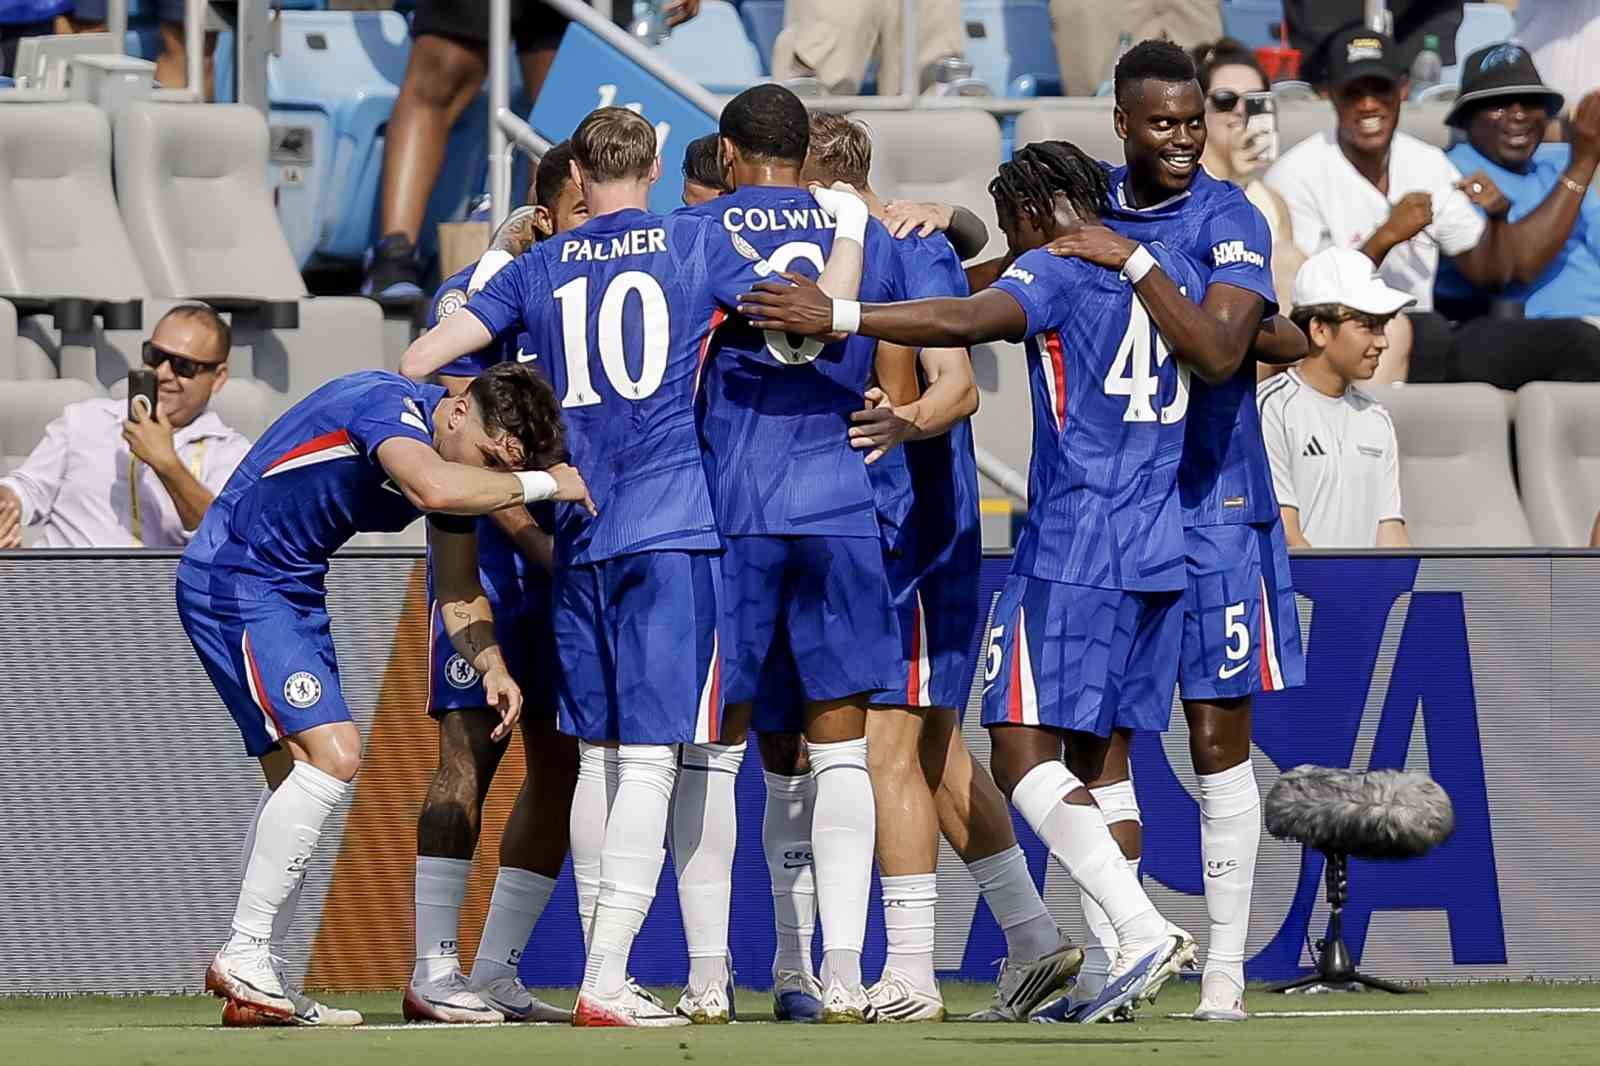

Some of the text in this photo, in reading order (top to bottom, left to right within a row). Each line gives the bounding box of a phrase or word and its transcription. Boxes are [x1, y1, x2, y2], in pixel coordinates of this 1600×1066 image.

[723, 207, 836, 232] COLWIL
[561, 227, 666, 262] PALMER
[553, 271, 670, 408] 10
[1225, 602, 1249, 660] 5
[1208, 859, 1237, 869] CFC
